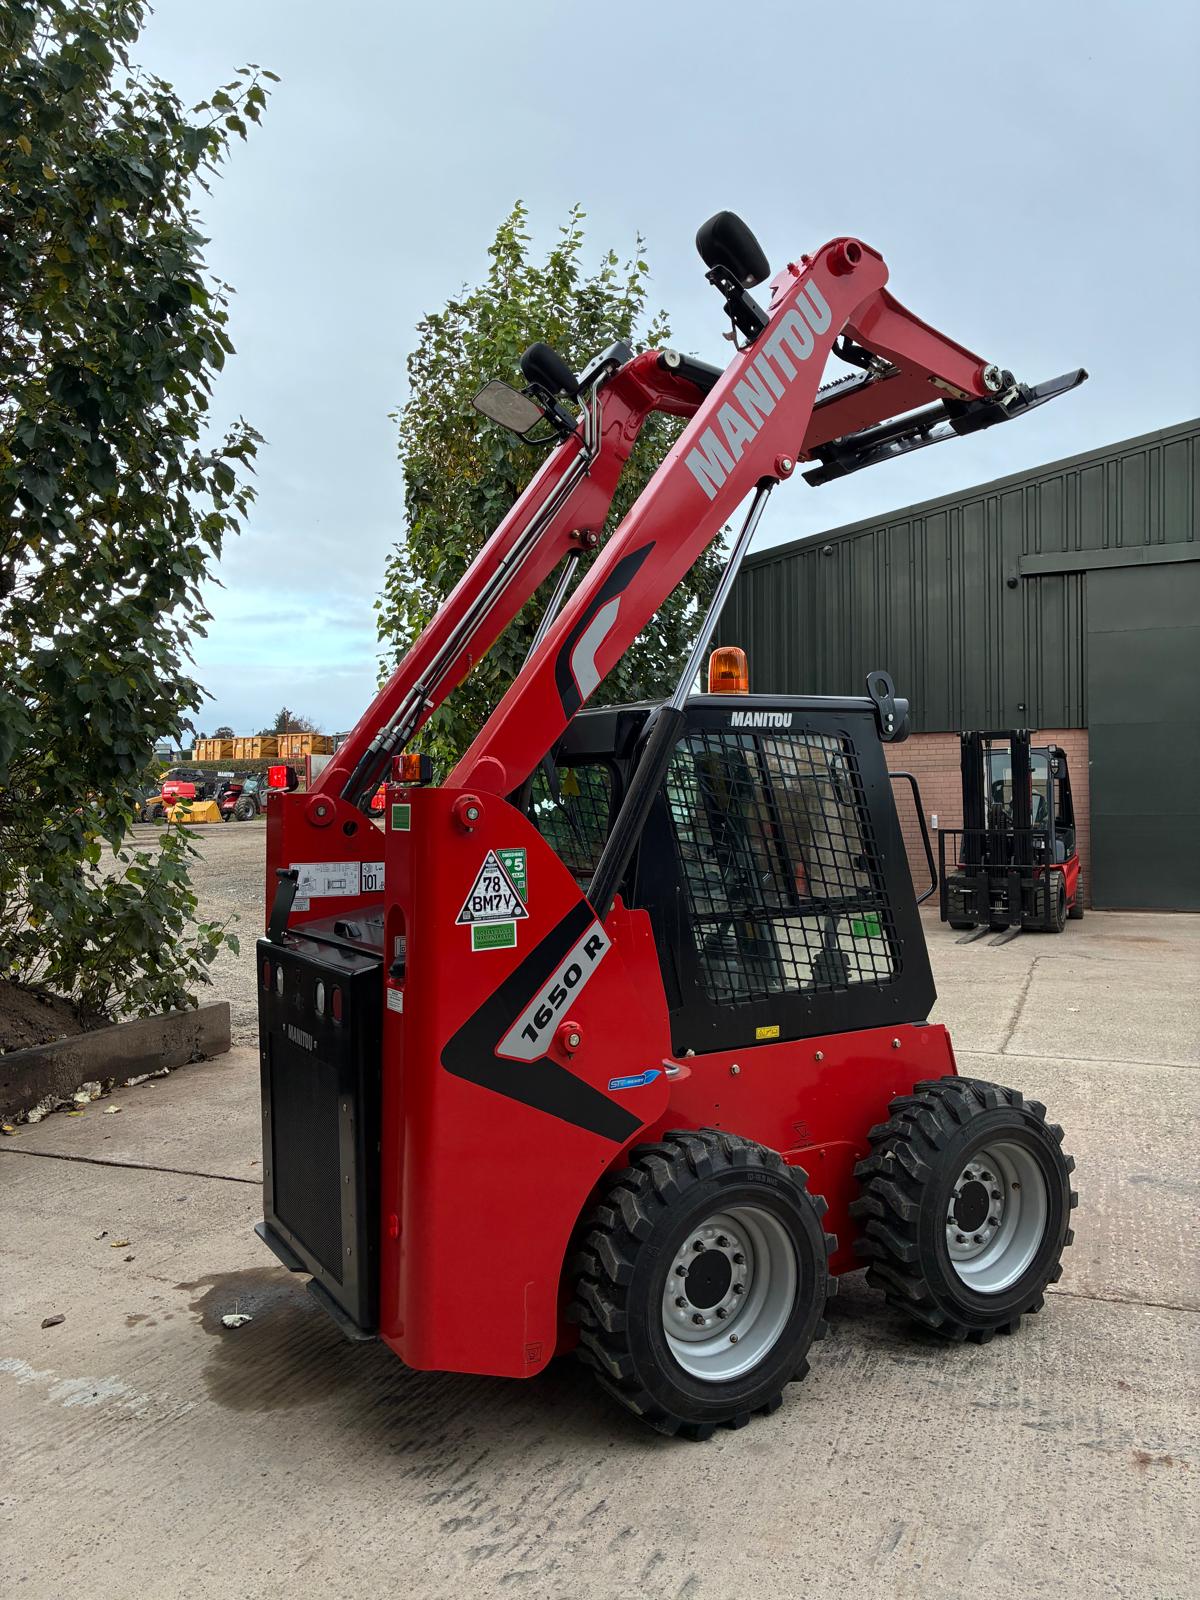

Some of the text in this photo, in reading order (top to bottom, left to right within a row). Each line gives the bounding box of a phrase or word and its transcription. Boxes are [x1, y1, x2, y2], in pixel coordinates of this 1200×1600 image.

[684, 278, 832, 501] MANITOU
[731, 711, 793, 728] MANITOU
[514, 858, 524, 871] 5
[363, 874, 377, 890] 101
[483, 876, 501, 894] 78
[473, 893, 512, 913] BM7Y
[521, 934, 605, 1043] 1650 R
[288, 1023, 313, 1051] MANITOU
